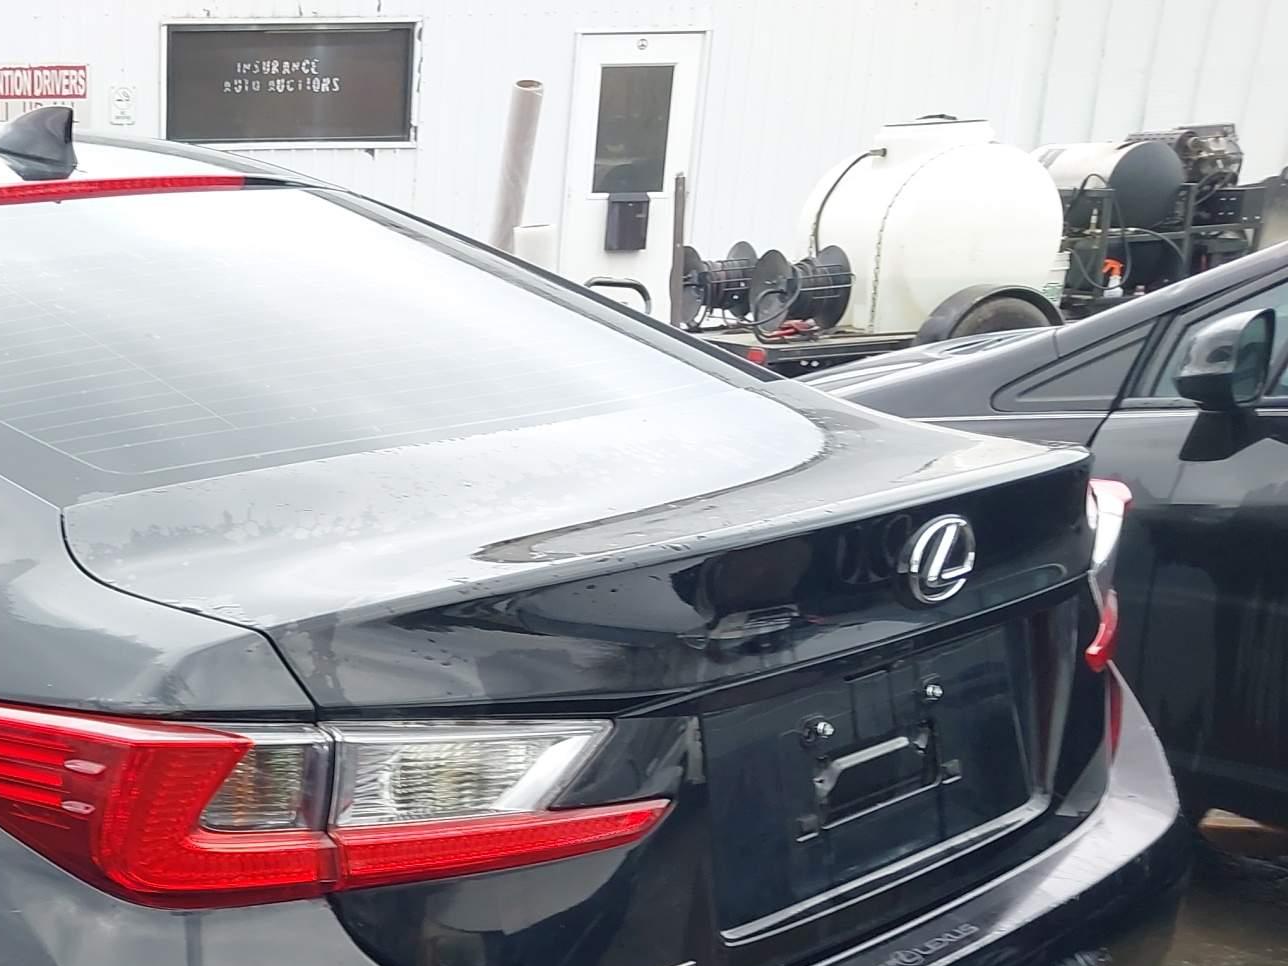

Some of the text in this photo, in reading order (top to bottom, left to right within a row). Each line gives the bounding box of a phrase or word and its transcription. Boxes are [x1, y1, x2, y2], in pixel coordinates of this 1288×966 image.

[236, 58, 320, 75] INSURANCE
[33, 68, 86, 97] DRIVERS
[914, 923, 979, 955] LEXUS
